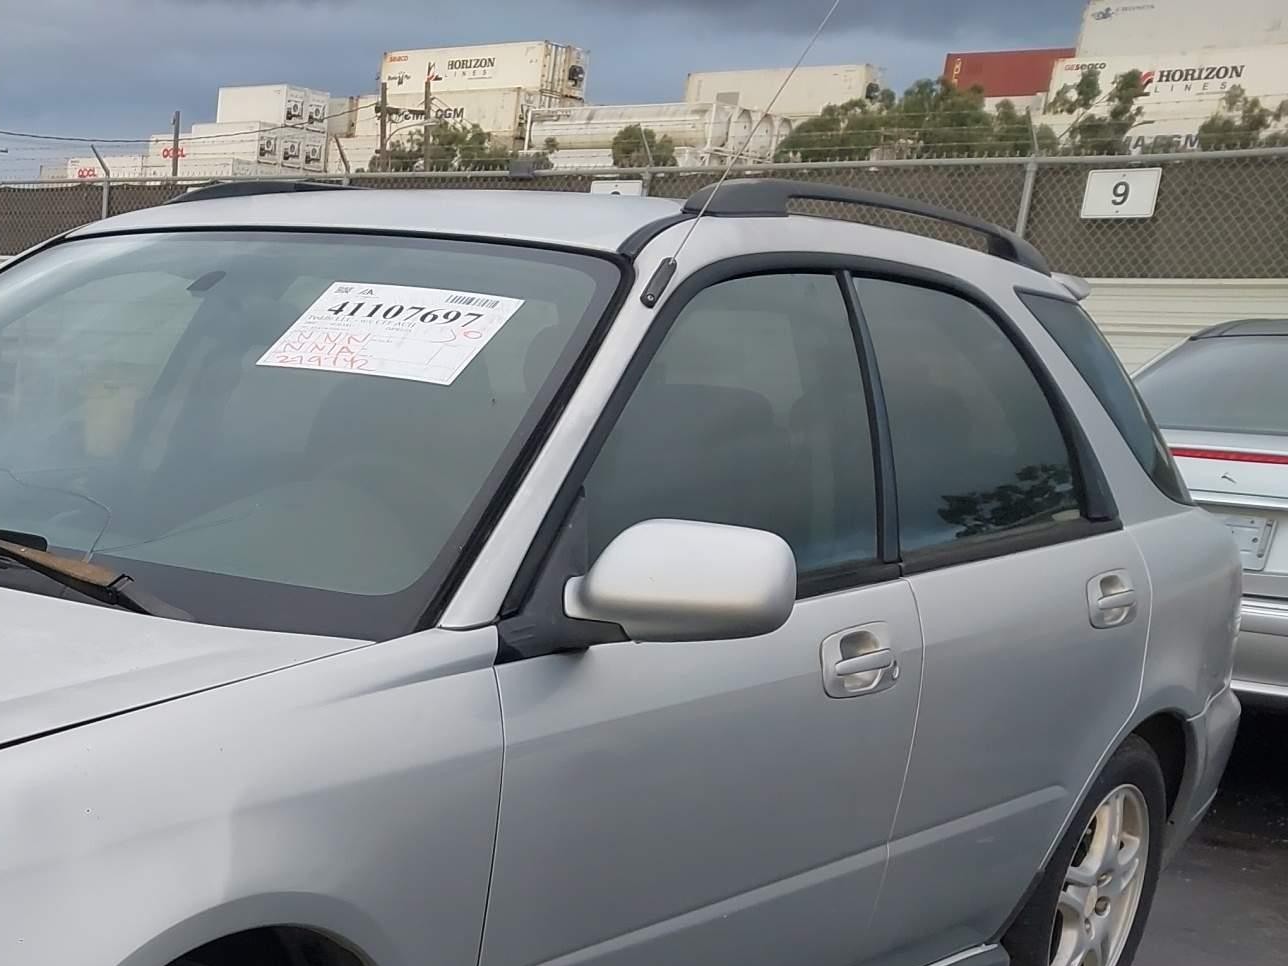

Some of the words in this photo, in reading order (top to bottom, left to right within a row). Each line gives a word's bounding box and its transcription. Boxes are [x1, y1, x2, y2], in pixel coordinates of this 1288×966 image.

[447, 57, 496, 70] HORIZON
[1157, 64, 1245, 83] HORIZON
[1153, 81, 1227, 93] LINES
[1111, 180, 1130, 206] 9
[327, 301, 484, 328] 41107697
